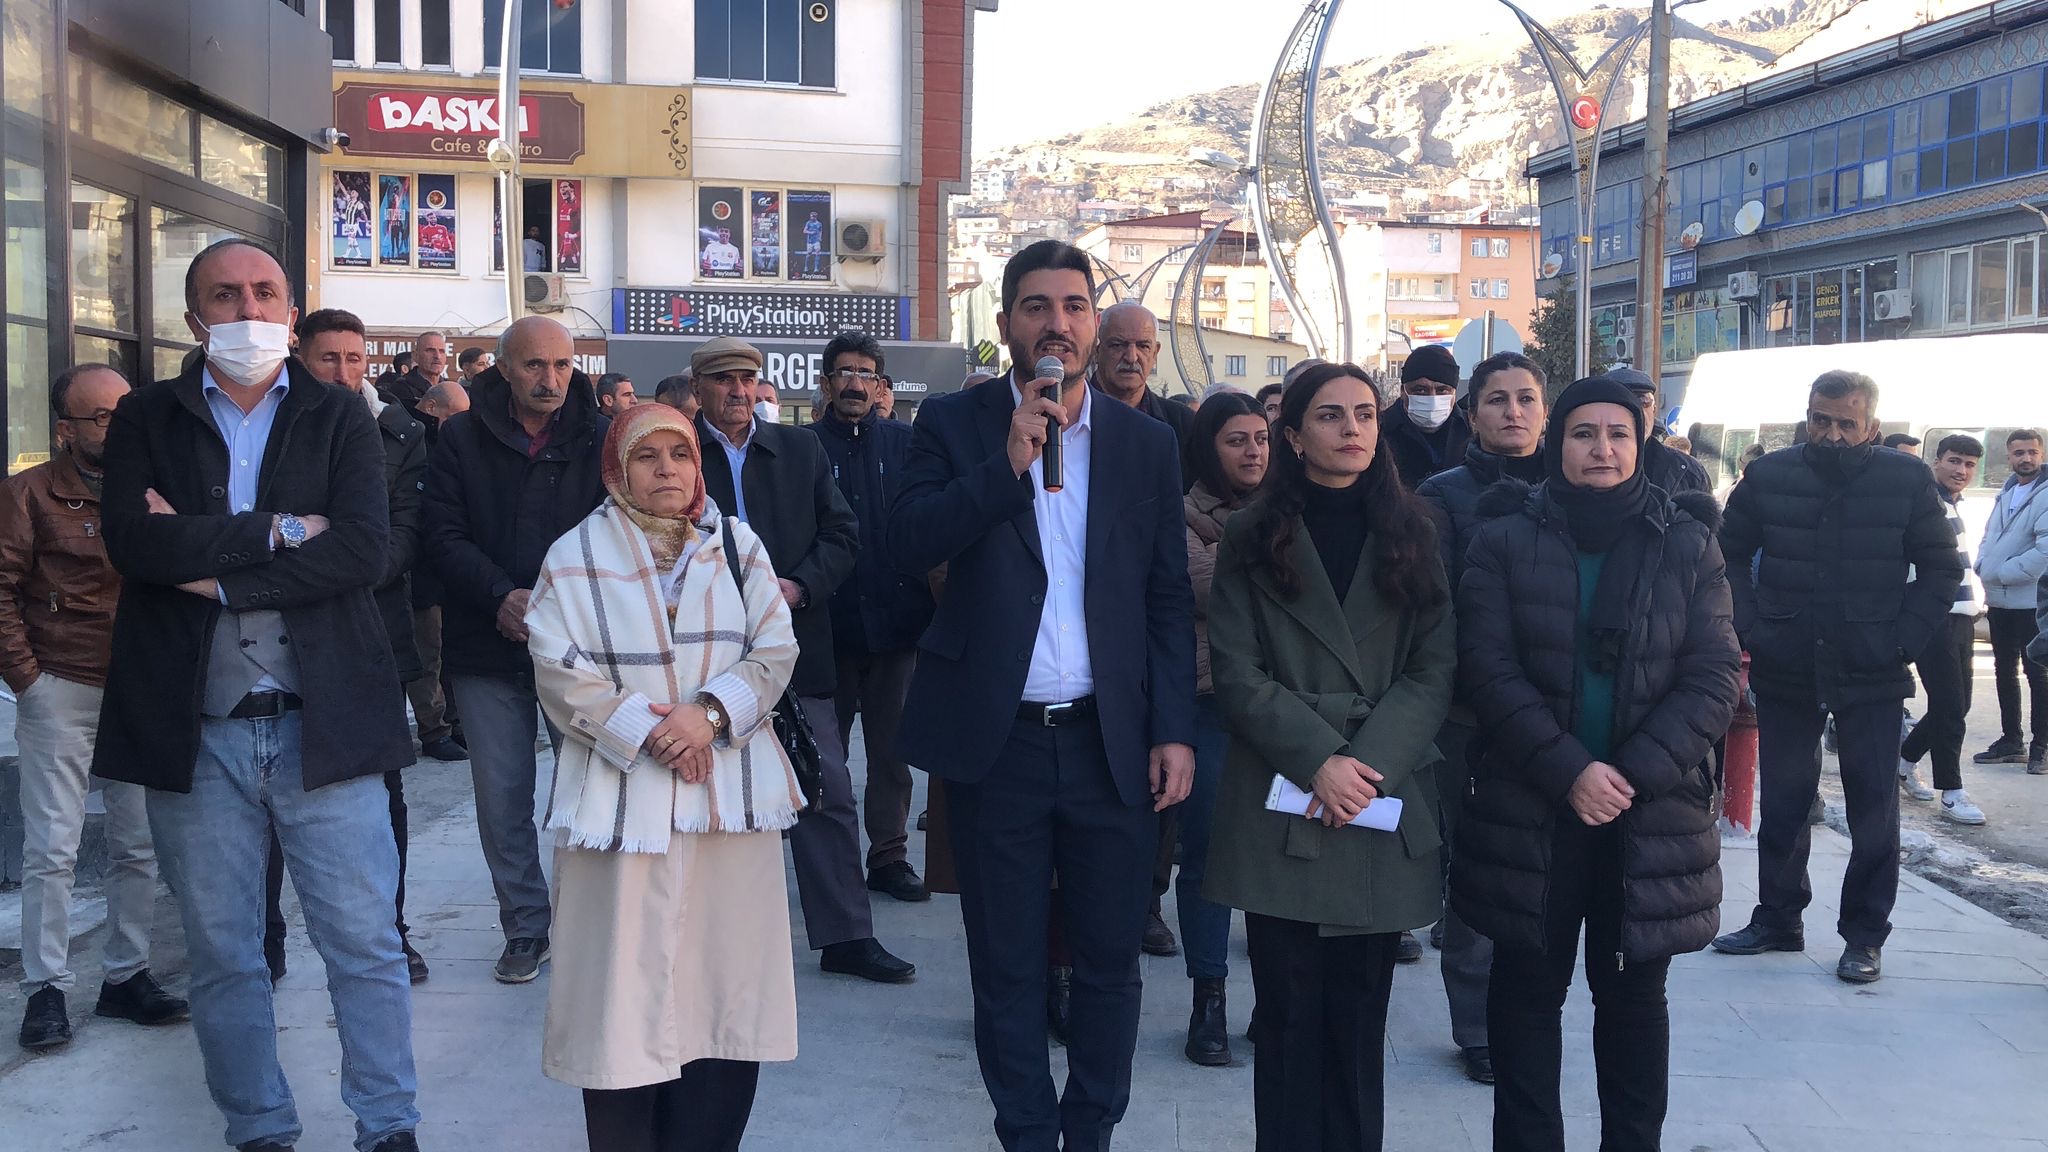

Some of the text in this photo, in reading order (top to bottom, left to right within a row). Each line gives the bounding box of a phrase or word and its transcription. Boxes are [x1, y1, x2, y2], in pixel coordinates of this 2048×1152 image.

[431, 137, 471, 152] Cafe
[477, 139, 489, 153] &
[1571, 234, 1621, 259] CFE
[1816, 295, 1840, 307] ERKEK
[707, 304, 825, 330] PlayStation
[838, 323, 864, 331] Milano
[891, 380, 928, 393] erfume
